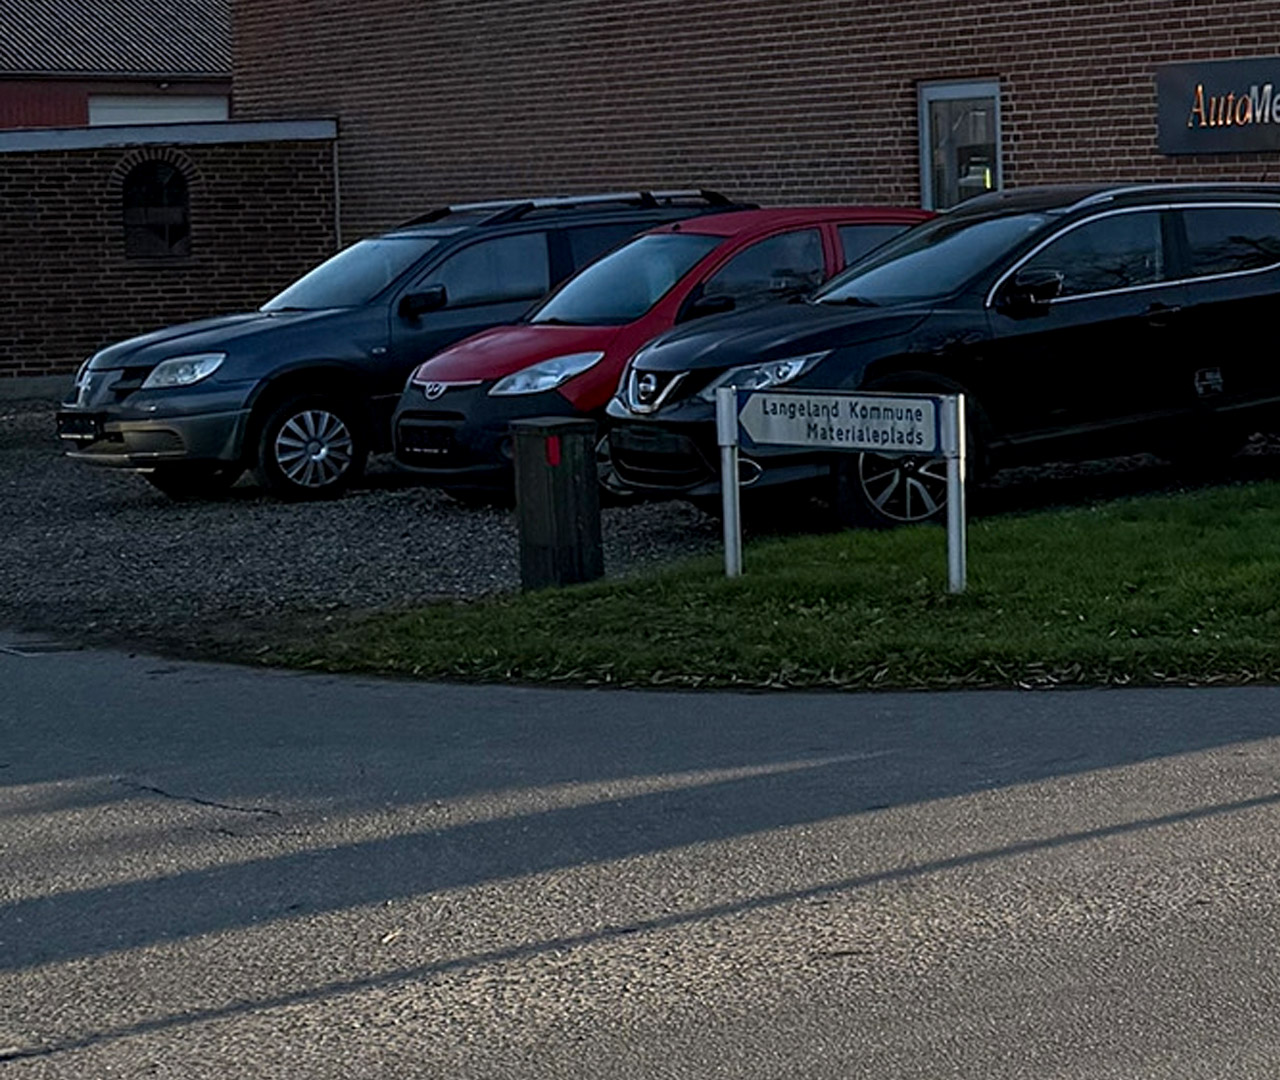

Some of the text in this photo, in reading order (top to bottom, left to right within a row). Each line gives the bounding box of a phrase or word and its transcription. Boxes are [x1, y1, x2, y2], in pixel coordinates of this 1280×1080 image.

[762, 398, 923, 422] Langeland Kommune
[806, 423, 924, 446] Materialeplads
